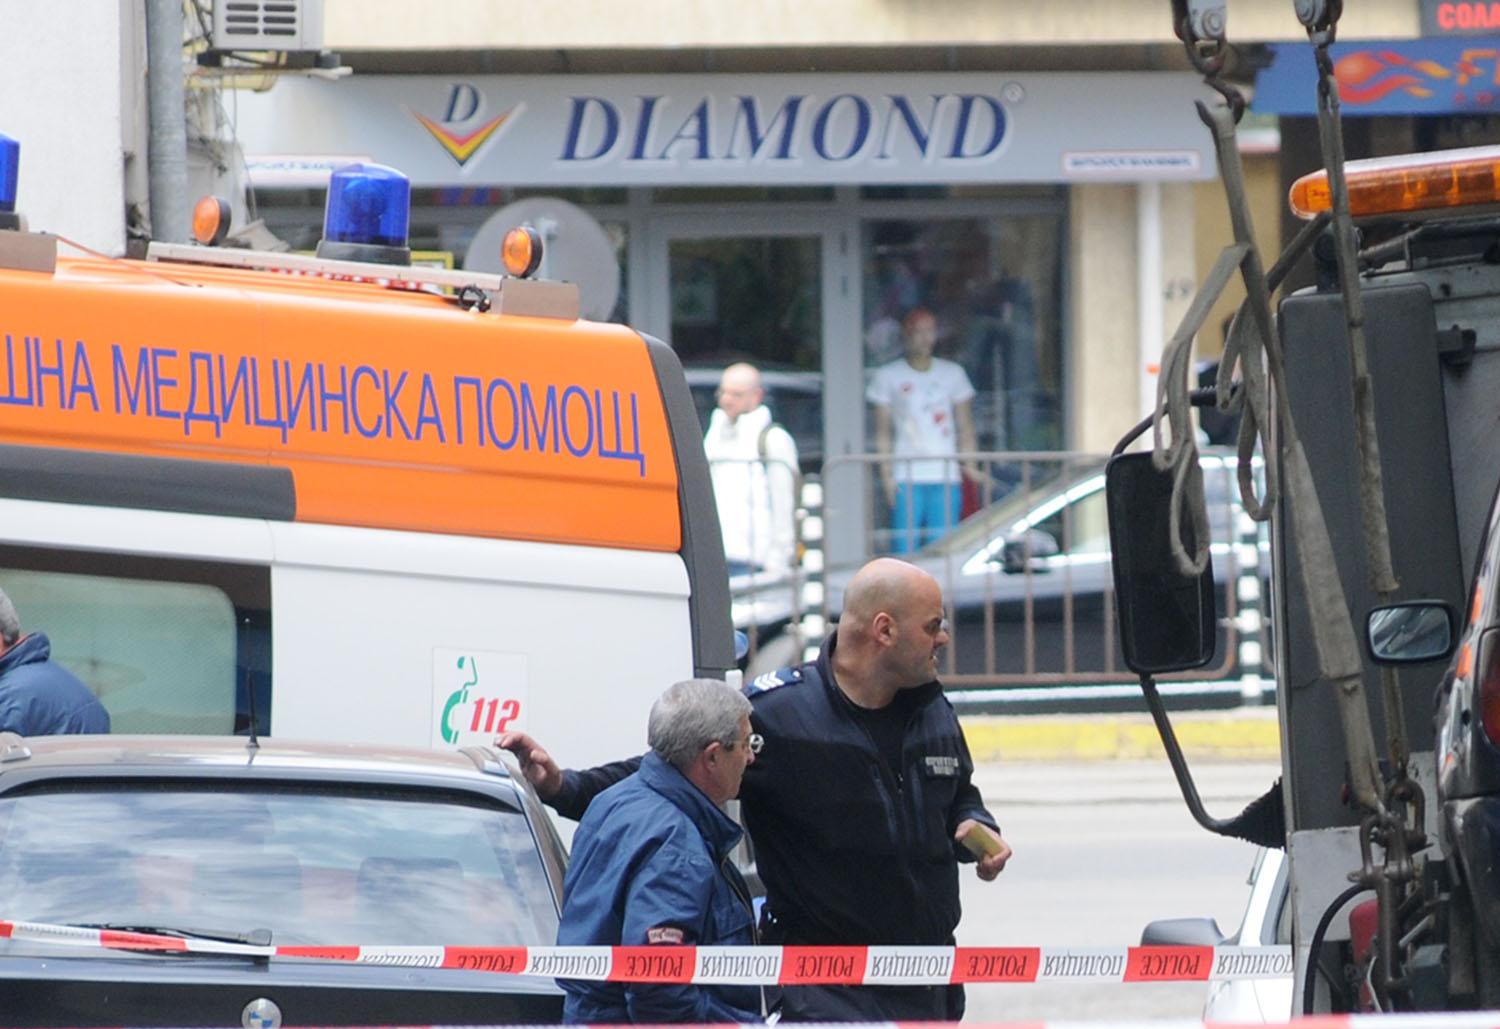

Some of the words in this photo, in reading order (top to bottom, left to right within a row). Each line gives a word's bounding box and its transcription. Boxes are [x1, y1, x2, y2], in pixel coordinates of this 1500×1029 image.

[443, 83, 480, 123] D
[558, 94, 1007, 161] DIAMOND
[111, 344, 446, 444] МЕДИЦИНСКА
[454, 376, 645, 477] ПОМОЩ
[470, 697, 520, 734] 112
[531, 952, 608, 975] ПОЛИЦИЯ
[625, 955, 684, 977] POLICE
[701, 951, 779, 977] ПОЛИЦИЯ
[795, 955, 855, 977] POLICE
[871, 951, 950, 976] ПОЛИЦИЯ
[967, 955, 1027, 976] POLICE
[1043, 951, 1123, 976] ПОЛИЦИЯ
[1139, 955, 1200, 975] POLICE
